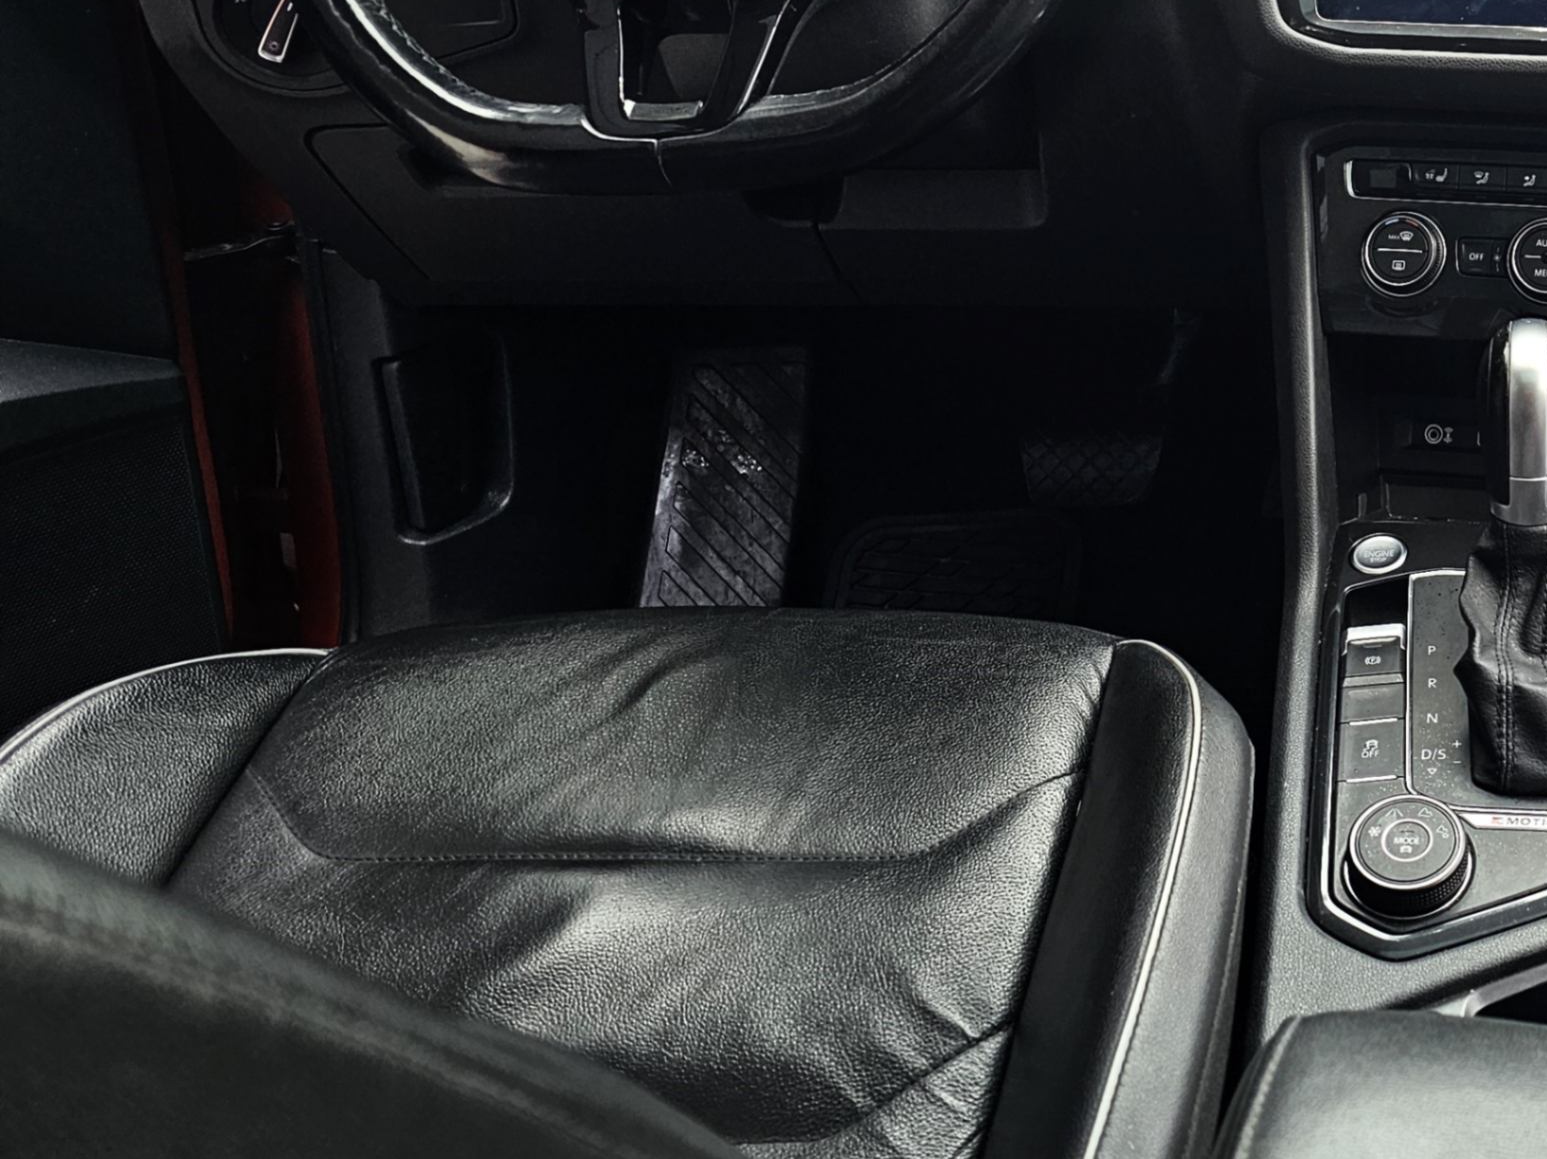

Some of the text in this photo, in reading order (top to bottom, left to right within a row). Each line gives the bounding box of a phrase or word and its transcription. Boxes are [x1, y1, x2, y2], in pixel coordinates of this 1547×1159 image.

[1469, 252, 1485, 261] OFF
[1363, 549, 1395, 558] ENGINE
[1427, 645, 1437, 656] P
[1427, 678, 1438, 689] R
[1426, 713, 1439, 724] N
[1361, 748, 1379, 759] OFF
[1421, 748, 1447, 761] D/S
[1393, 836, 1420, 845] MODE
